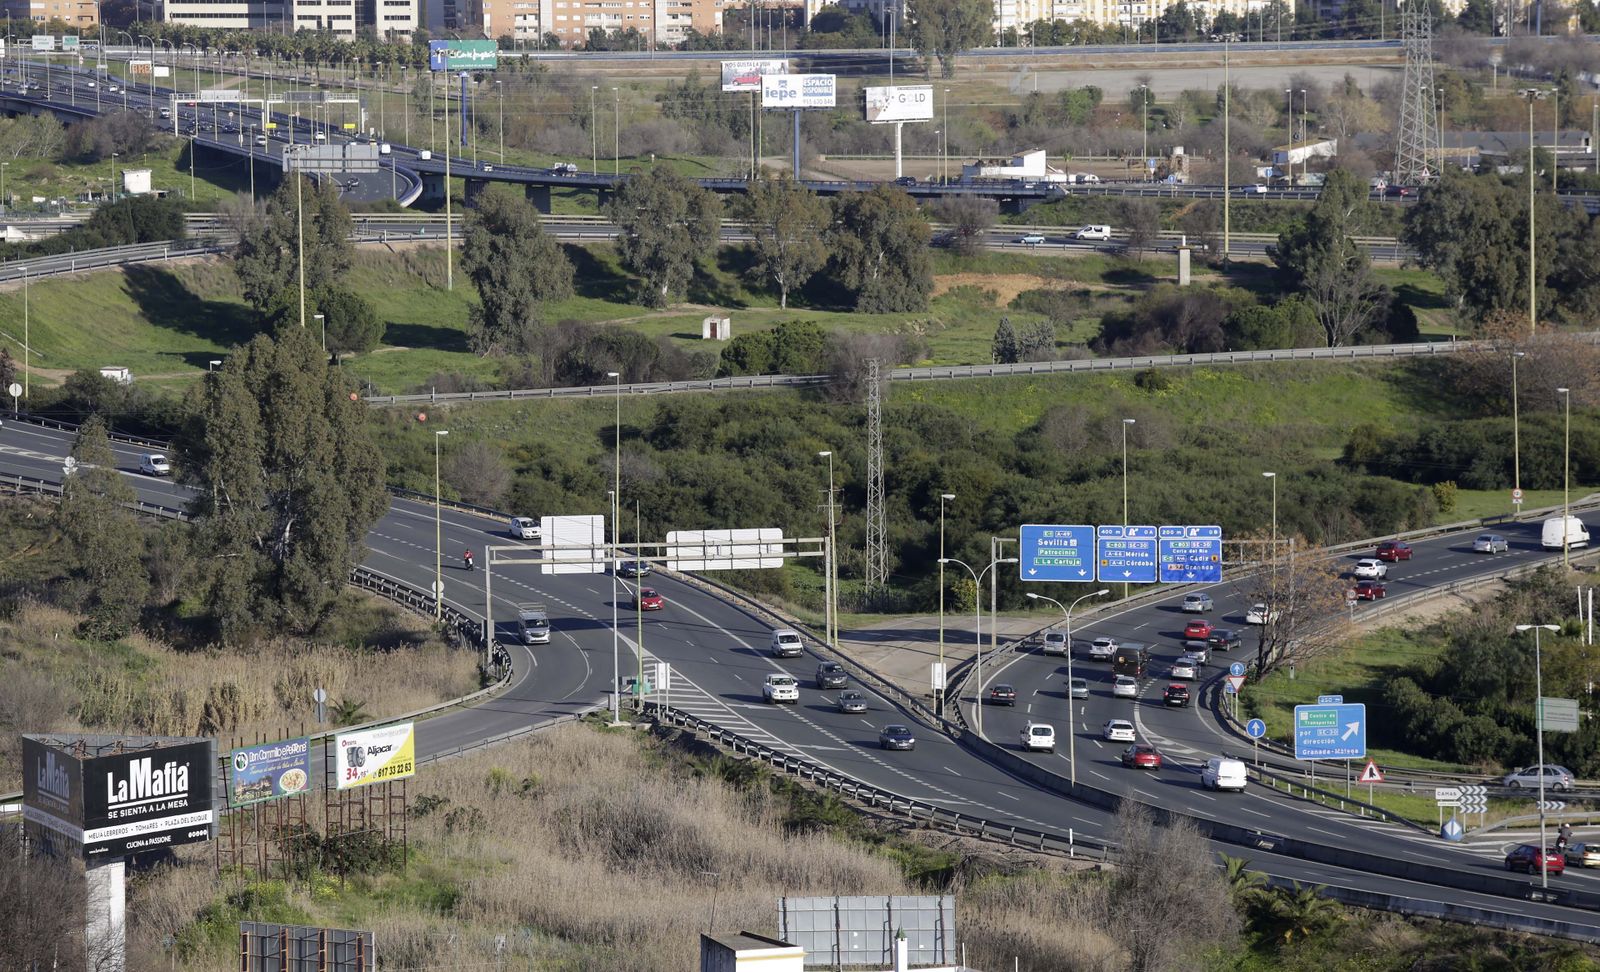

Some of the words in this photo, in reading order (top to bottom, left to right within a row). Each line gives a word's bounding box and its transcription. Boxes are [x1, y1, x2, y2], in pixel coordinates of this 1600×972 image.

[766, 87, 797, 100] iepe
[367, 744, 392, 756] Aljacar
[378, 768, 388, 778] 617
[389, 766, 396, 775] 33
[397, 764, 404, 774] 22
[405, 762, 412, 772] 63
[108, 810, 118, 819] SE
[120, 806, 147, 817] SIENTA
[156, 803, 166, 812] LA
[168, 799, 188, 809] MESA
[104, 828, 128, 838] LEBREROS
[136, 822, 158, 832] TOMARES
[165, 818, 180, 827] PLAZA
[191, 814, 208, 823] DUQUE
[126, 840, 145, 849] CUCINA
[149, 835, 172, 846] PASSIONE
